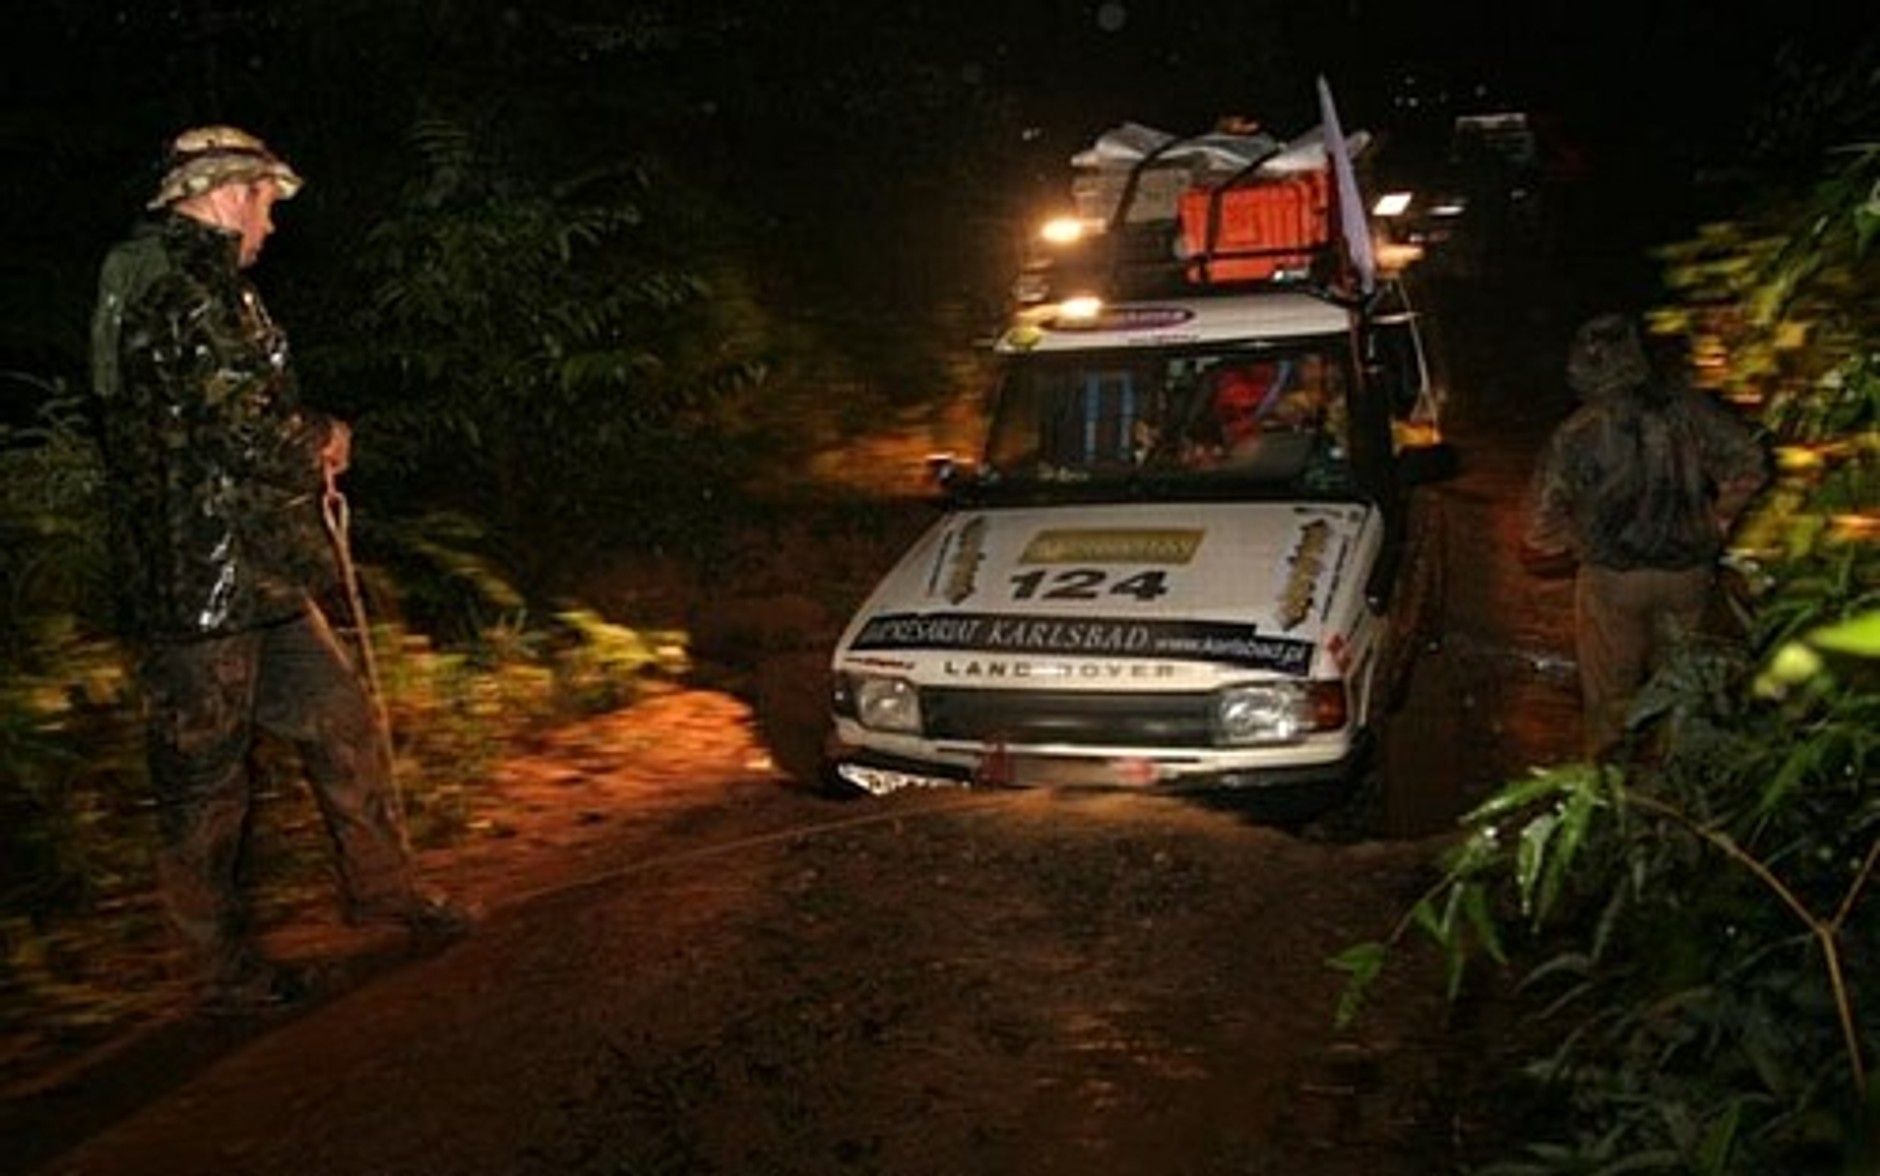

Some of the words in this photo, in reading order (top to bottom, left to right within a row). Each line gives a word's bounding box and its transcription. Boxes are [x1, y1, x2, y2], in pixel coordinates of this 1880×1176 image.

[1010, 568, 1168, 601] 124
[987, 620, 1150, 650] KARLSBAD
[943, 660, 1032, 678] LAND
